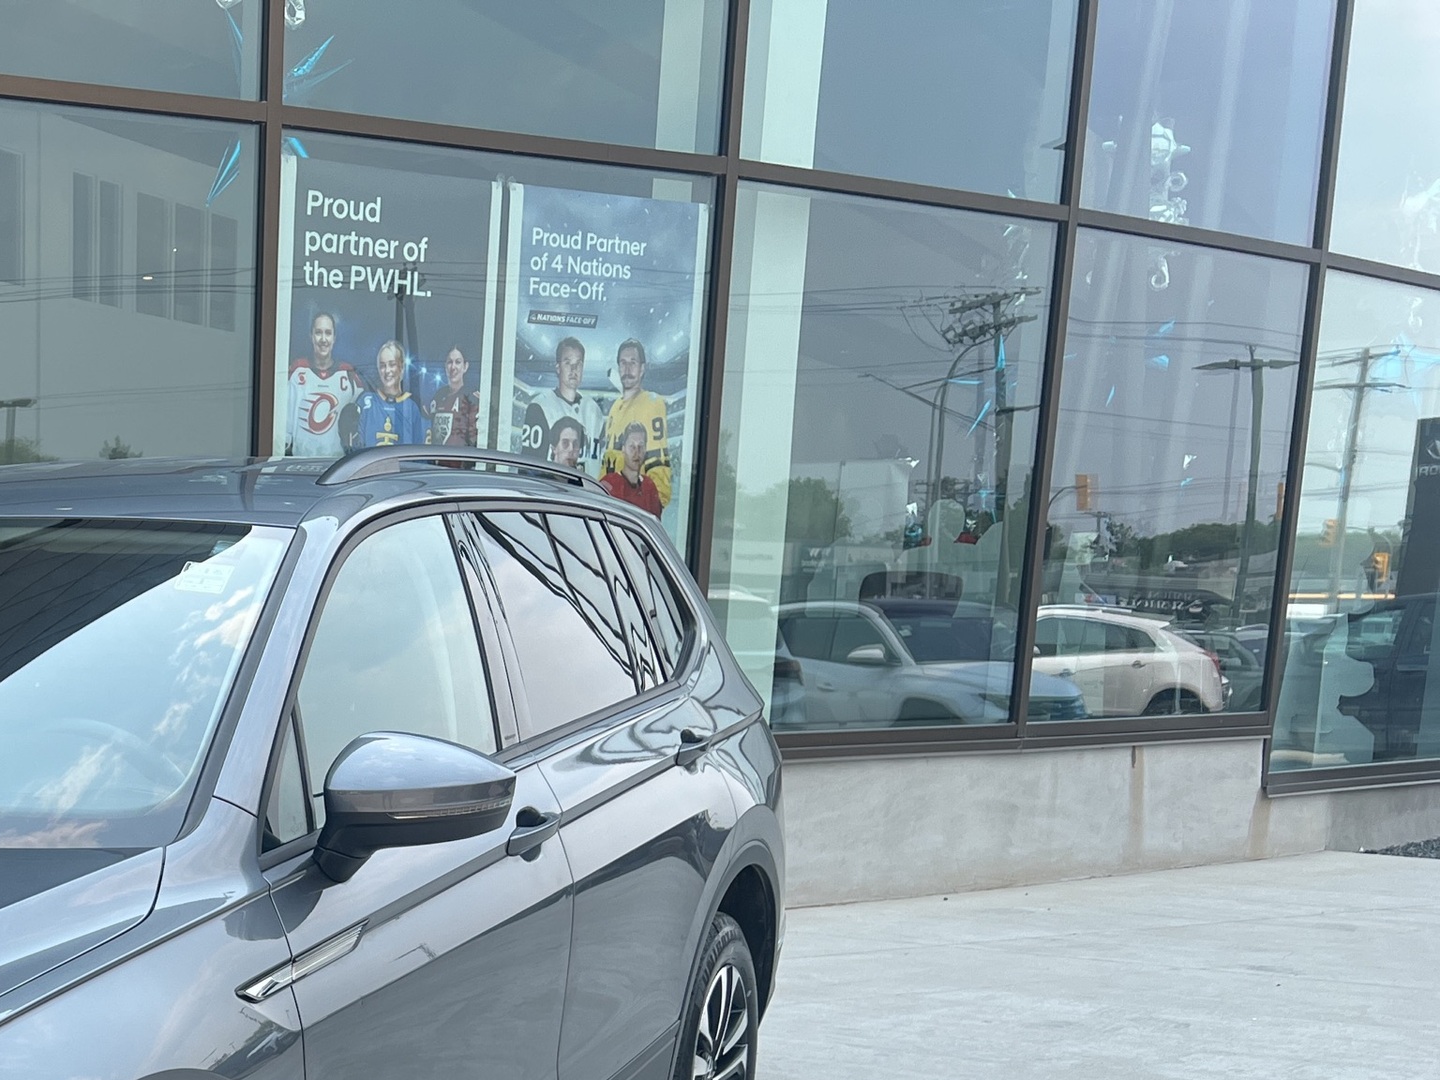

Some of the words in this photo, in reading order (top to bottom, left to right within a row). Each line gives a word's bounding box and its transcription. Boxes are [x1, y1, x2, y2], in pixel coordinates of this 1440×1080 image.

[306, 189, 382, 223] Proud
[304, 231, 400, 259] partner
[402, 236, 429, 263] of
[531, 227, 582, 250] Proud
[586, 232, 648, 256] Partner
[530, 252, 549, 272] of
[550, 254, 564, 273] 4
[567, 255, 632, 279] Nations
[303, 260, 344, 289] the
[349, 265, 432, 298] PWHL.
[529, 276, 607, 302] Face-Off.
[536, 313, 567, 323] NATIONS
[340, 375, 349, 392] C
[451, 396, 460, 413] A
[522, 423, 543, 449] 20
[652, 416, 665, 441] 9
